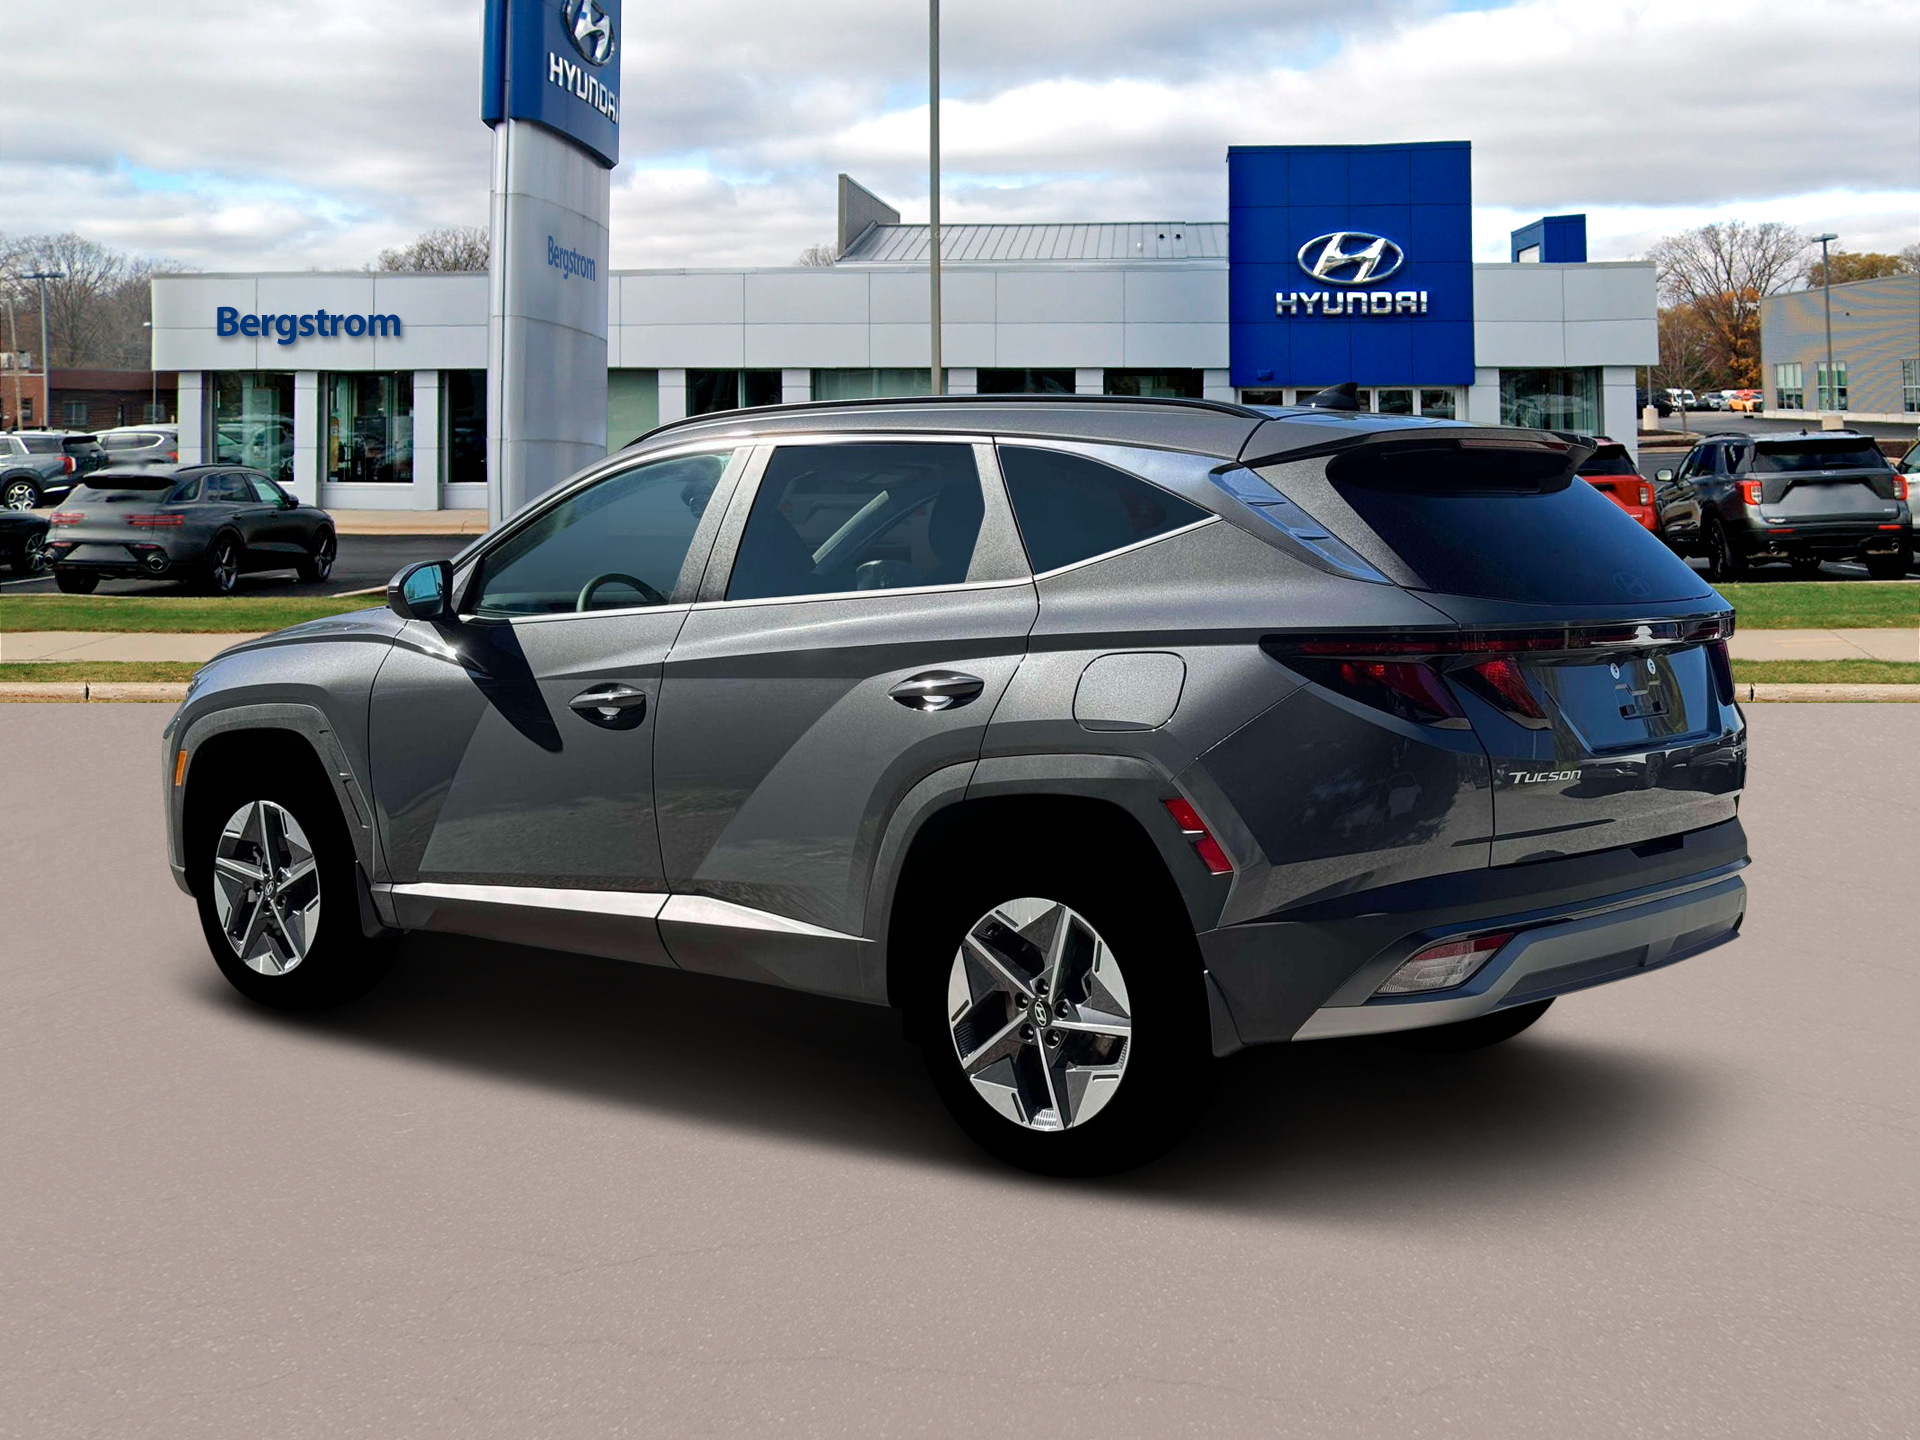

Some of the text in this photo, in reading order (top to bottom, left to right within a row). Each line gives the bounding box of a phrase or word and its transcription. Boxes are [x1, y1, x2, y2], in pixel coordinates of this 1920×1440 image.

[549, 52, 618, 124] HYUNDAI
[547, 235, 596, 282] Bergstrom
[1275, 291, 1428, 315] HYUNDAI
[217, 306, 402, 346] Bergstrom
